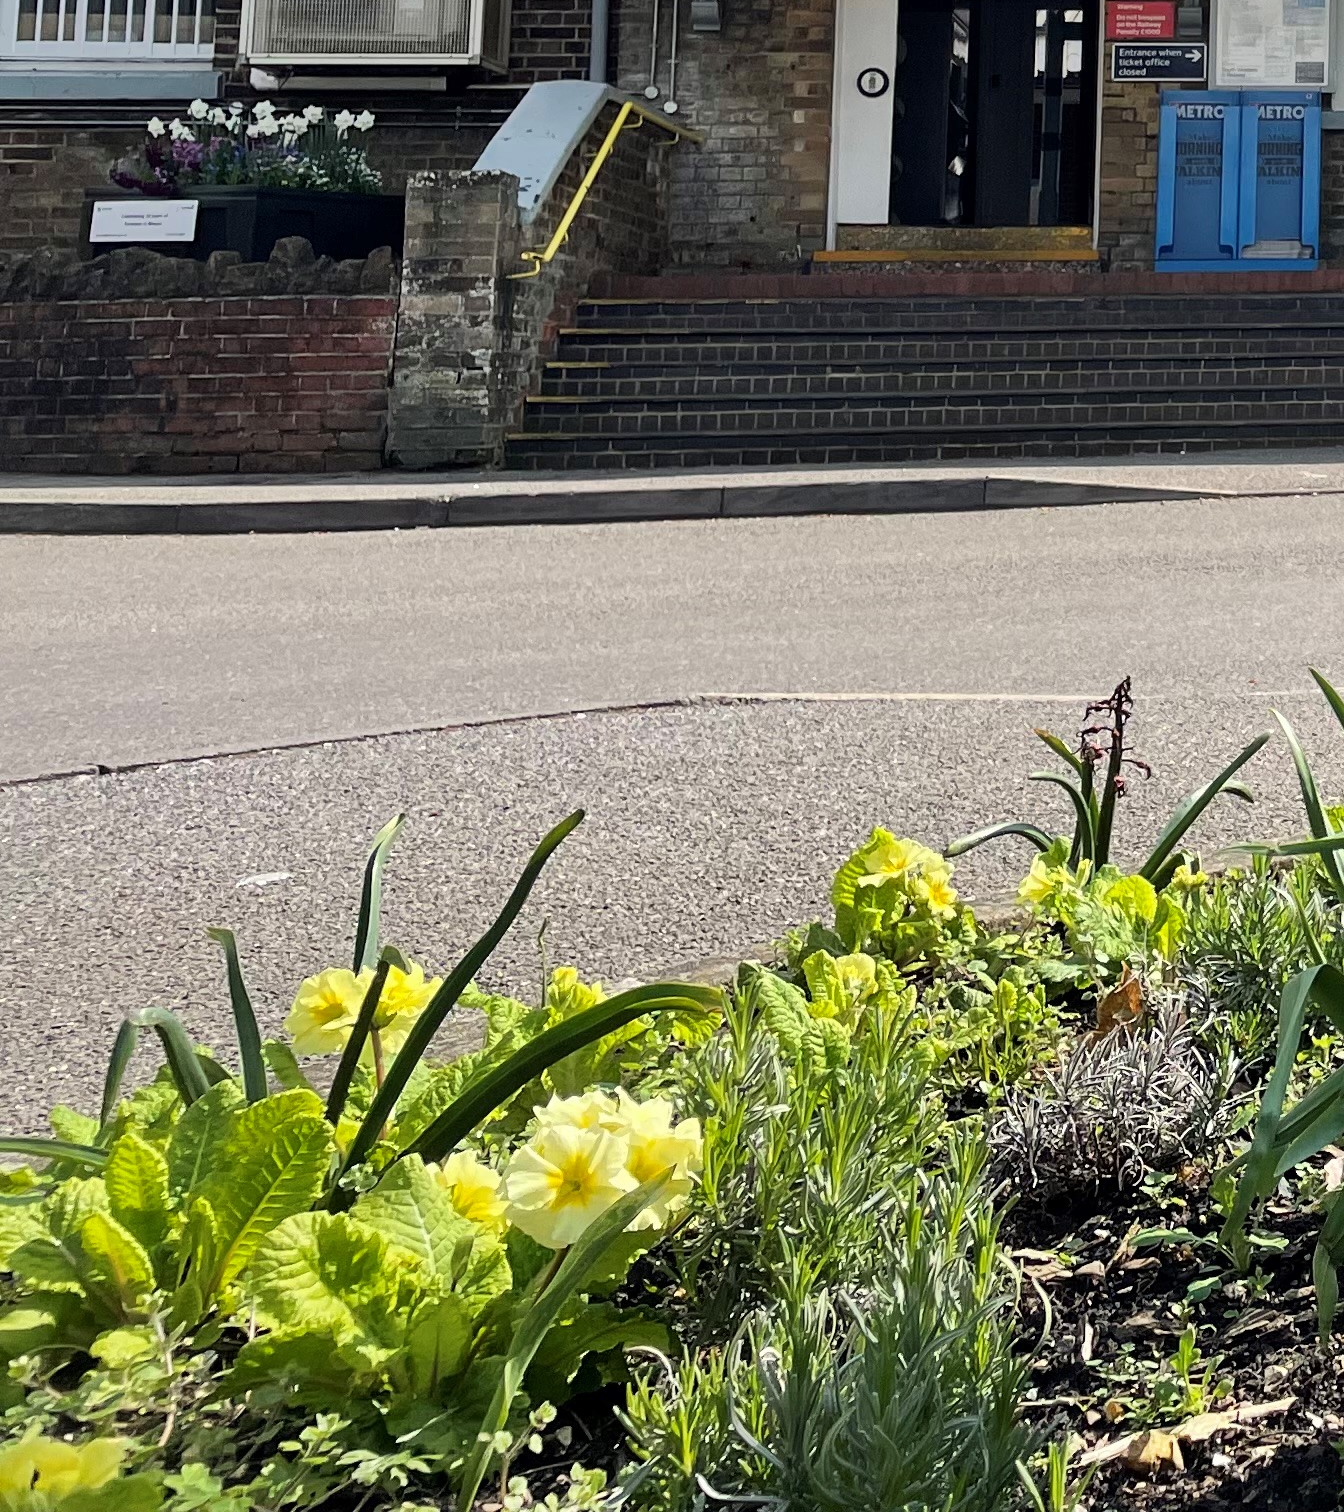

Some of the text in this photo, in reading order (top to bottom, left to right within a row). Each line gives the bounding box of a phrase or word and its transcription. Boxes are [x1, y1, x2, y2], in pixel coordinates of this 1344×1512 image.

[1119, 48, 1182, 57] Entrance when
[1119, 58, 1171, 67] ticket office
[1118, 68, 1147, 76] closed
[1175, 104, 1224, 119] METRO
